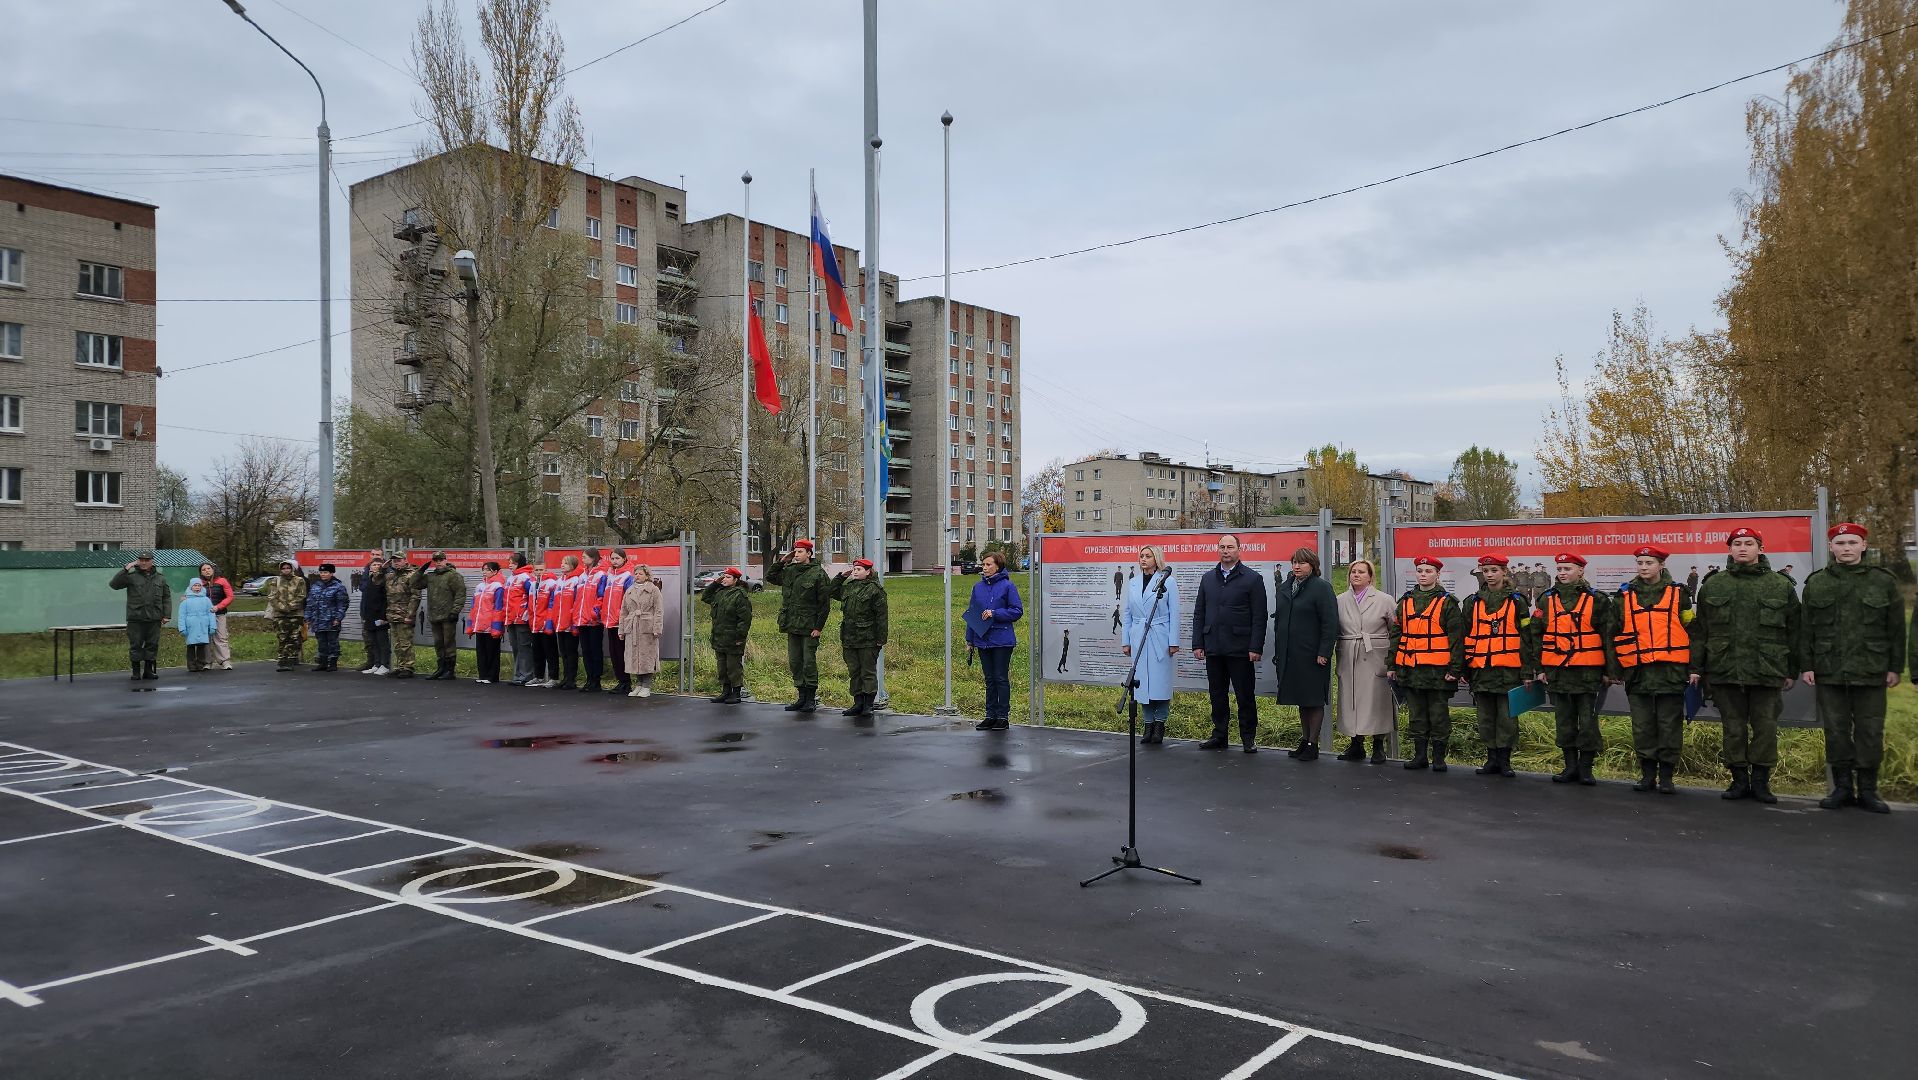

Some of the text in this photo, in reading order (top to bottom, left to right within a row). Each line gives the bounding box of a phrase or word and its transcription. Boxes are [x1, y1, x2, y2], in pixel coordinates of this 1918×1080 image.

[1428, 537, 1481, 548] ВЫПОЛНЕНИЕ
[1484, 536, 1532, 547] ВОИНСКОГО
[1534, 535, 1594, 546] ПРИВЕТСТВИЯ
[1596, 534, 1602, 544] В
[1604, 534, 1635, 545] СТРОЮ
[1637, 533, 1650, 544] НА
[1652, 532, 1684, 543] МЕСТЕ
[1686, 532, 1693, 543] И
[1695, 532, 1702, 543] В
[1180, 544, 1193, 553] БЕЗ
